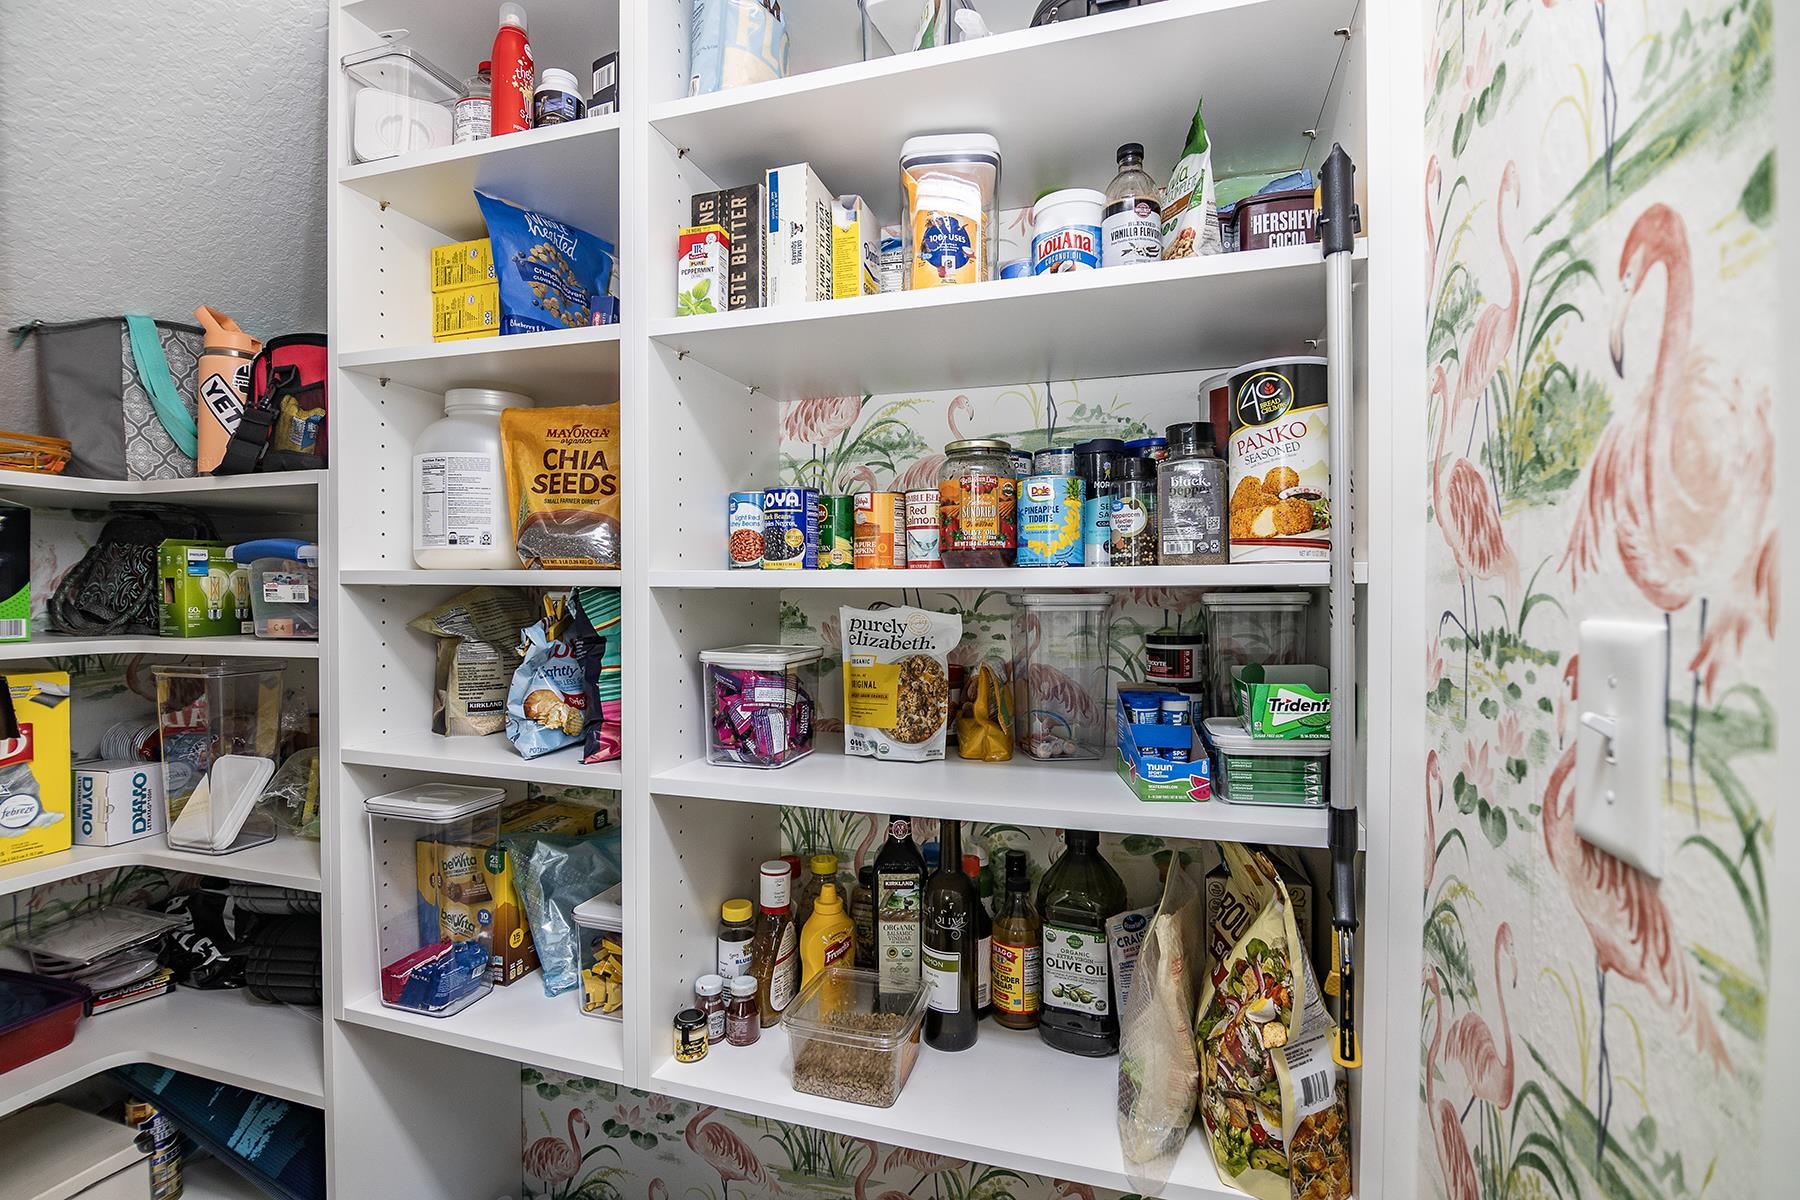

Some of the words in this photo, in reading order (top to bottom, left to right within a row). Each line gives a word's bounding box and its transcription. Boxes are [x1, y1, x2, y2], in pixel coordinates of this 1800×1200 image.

[700, 200, 714, 224] NS
[818, 197, 826, 229] BEAT
[1128, 220, 1157, 228] BLENDED
[1252, 209, 1315, 235] HERSHEY
[524, 214, 576, 259] hearted
[731, 195, 747, 266] BETTER
[1110, 226, 1138, 241] VANILLA
[819, 234, 825, 249] TO
[949, 234, 966, 243] USES
[1269, 231, 1307, 248] COCOA
[1038, 232, 1092, 261] LouAna
[825, 258, 831, 273] OF
[1045, 251, 1070, 266] COCONUT
[1072, 251, 1082, 260] OIL
[680, 266, 714, 276] PEPPERMINT
[731, 271, 747, 310] STE
[510, 319, 535, 331] Blueberry
[1240, 377, 1282, 421] 4C
[1260, 397, 1281, 409] BREAD
[206, 380, 242, 433] YET
[546, 424, 610, 438] MAYORGA
[560, 438, 592, 448] organics
[1237, 421, 1307, 457] PANKO
[543, 448, 609, 471] CHIA
[1244, 441, 1301, 466] SEASONED
[531, 472, 617, 496] SEEDS
[1170, 475, 1211, 487] black
[1032, 486, 1051, 495] Dole
[1169, 485, 1212, 498] pepper
[764, 492, 799, 508] OYA
[1100, 503, 1109, 511] SE
[910, 505, 928, 516] Red
[1024, 505, 1060, 514] PINEAPPLE
[1099, 511, 1109, 519] SA
[735, 514, 747, 522] Light
[1028, 514, 1054, 523] TIDBITS
[849, 618, 908, 637] purely
[469, 701, 503, 709] KIRKLAND
[569, 697, 585, 706] Orig
[1268, 698, 1330, 712] Trident
[1146, 763, 1173, 771] nuun
[82, 776, 93, 836] DYMO
[132, 772, 147, 835] DYMO
[0, 804, 36, 818] febreze
[480, 912, 489, 920] 10
[513, 933, 521, 942] 15
[1117, 931, 1147, 948] CRAIS
[826, 940, 850, 963] French's
[1056, 953, 1074, 961] EXTRA
[1074, 956, 1094, 964] VIRGIN
[1060, 948, 1090, 958] ORGANIC
[926, 956, 944, 968] MON
[1045, 957, 1082, 973] OLIVE
[1085, 965, 1107, 976] OIL
[1000, 974, 1020, 984] CIDER
